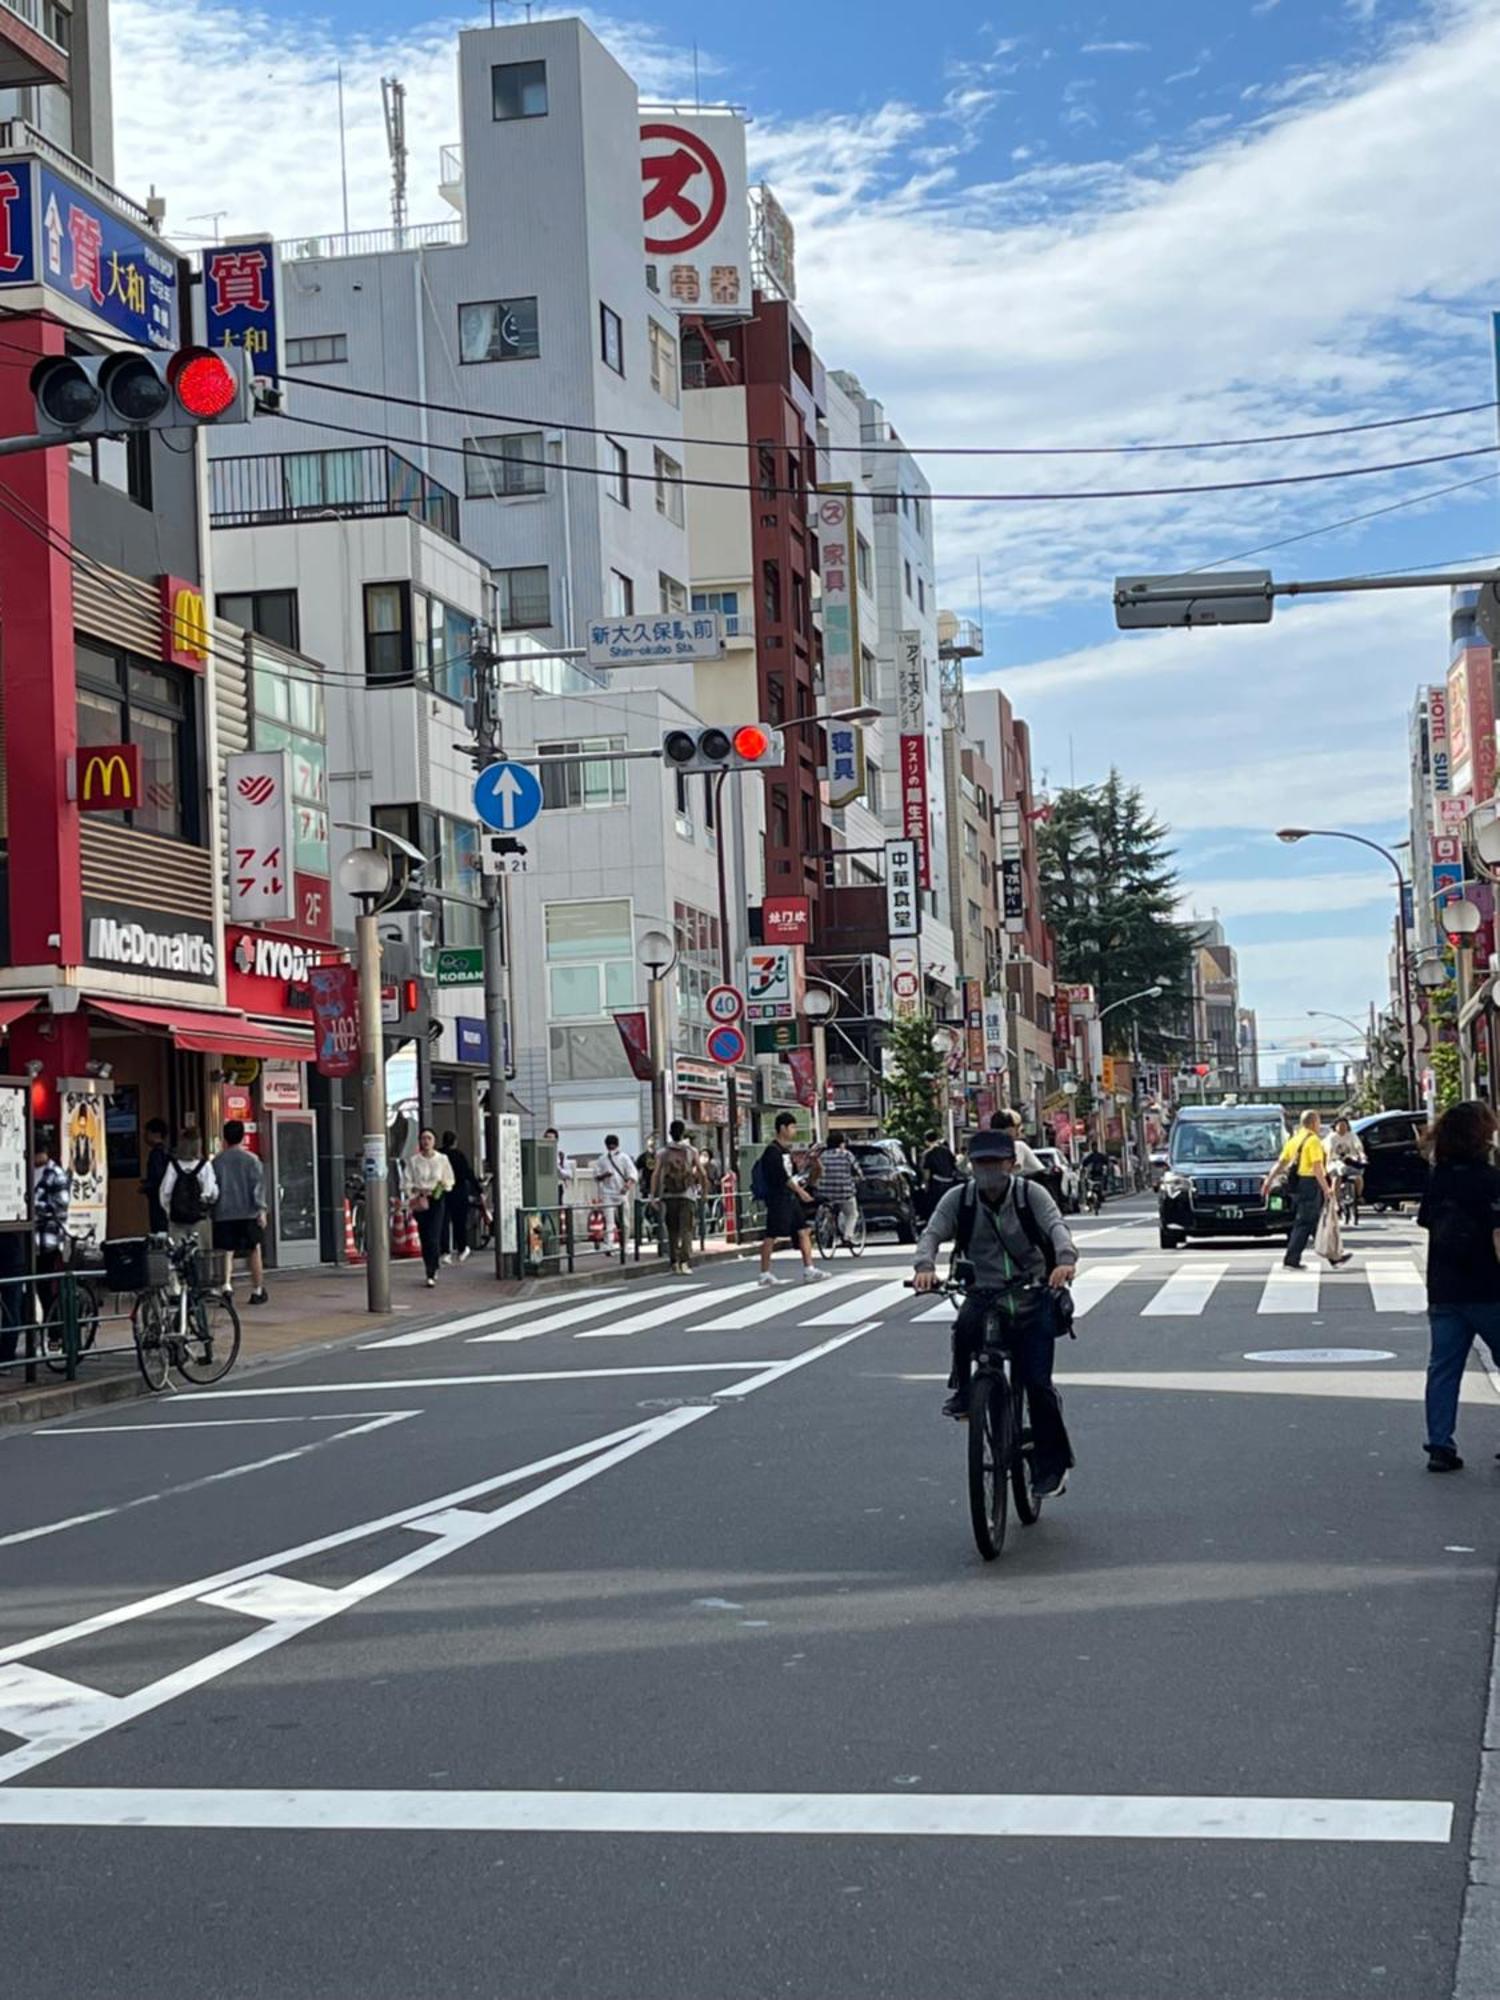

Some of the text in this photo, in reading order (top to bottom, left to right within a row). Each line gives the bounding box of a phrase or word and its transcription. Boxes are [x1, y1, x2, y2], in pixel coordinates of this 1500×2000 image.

[68, 203, 105, 305] 質
[107, 250, 145, 315] 大和
[209, 250, 270, 316] 質
[592, 620, 712, 645] 新大久保駅前
[1430, 691, 1449, 791] HOTEL SUN
[305, 893, 321, 926] 2F
[892, 851, 912, 928] 中華食堂
[89, 918, 215, 976] McDonald's
[439, 970, 485, 982] KOBAN
[715, 996, 735, 1013] 40
